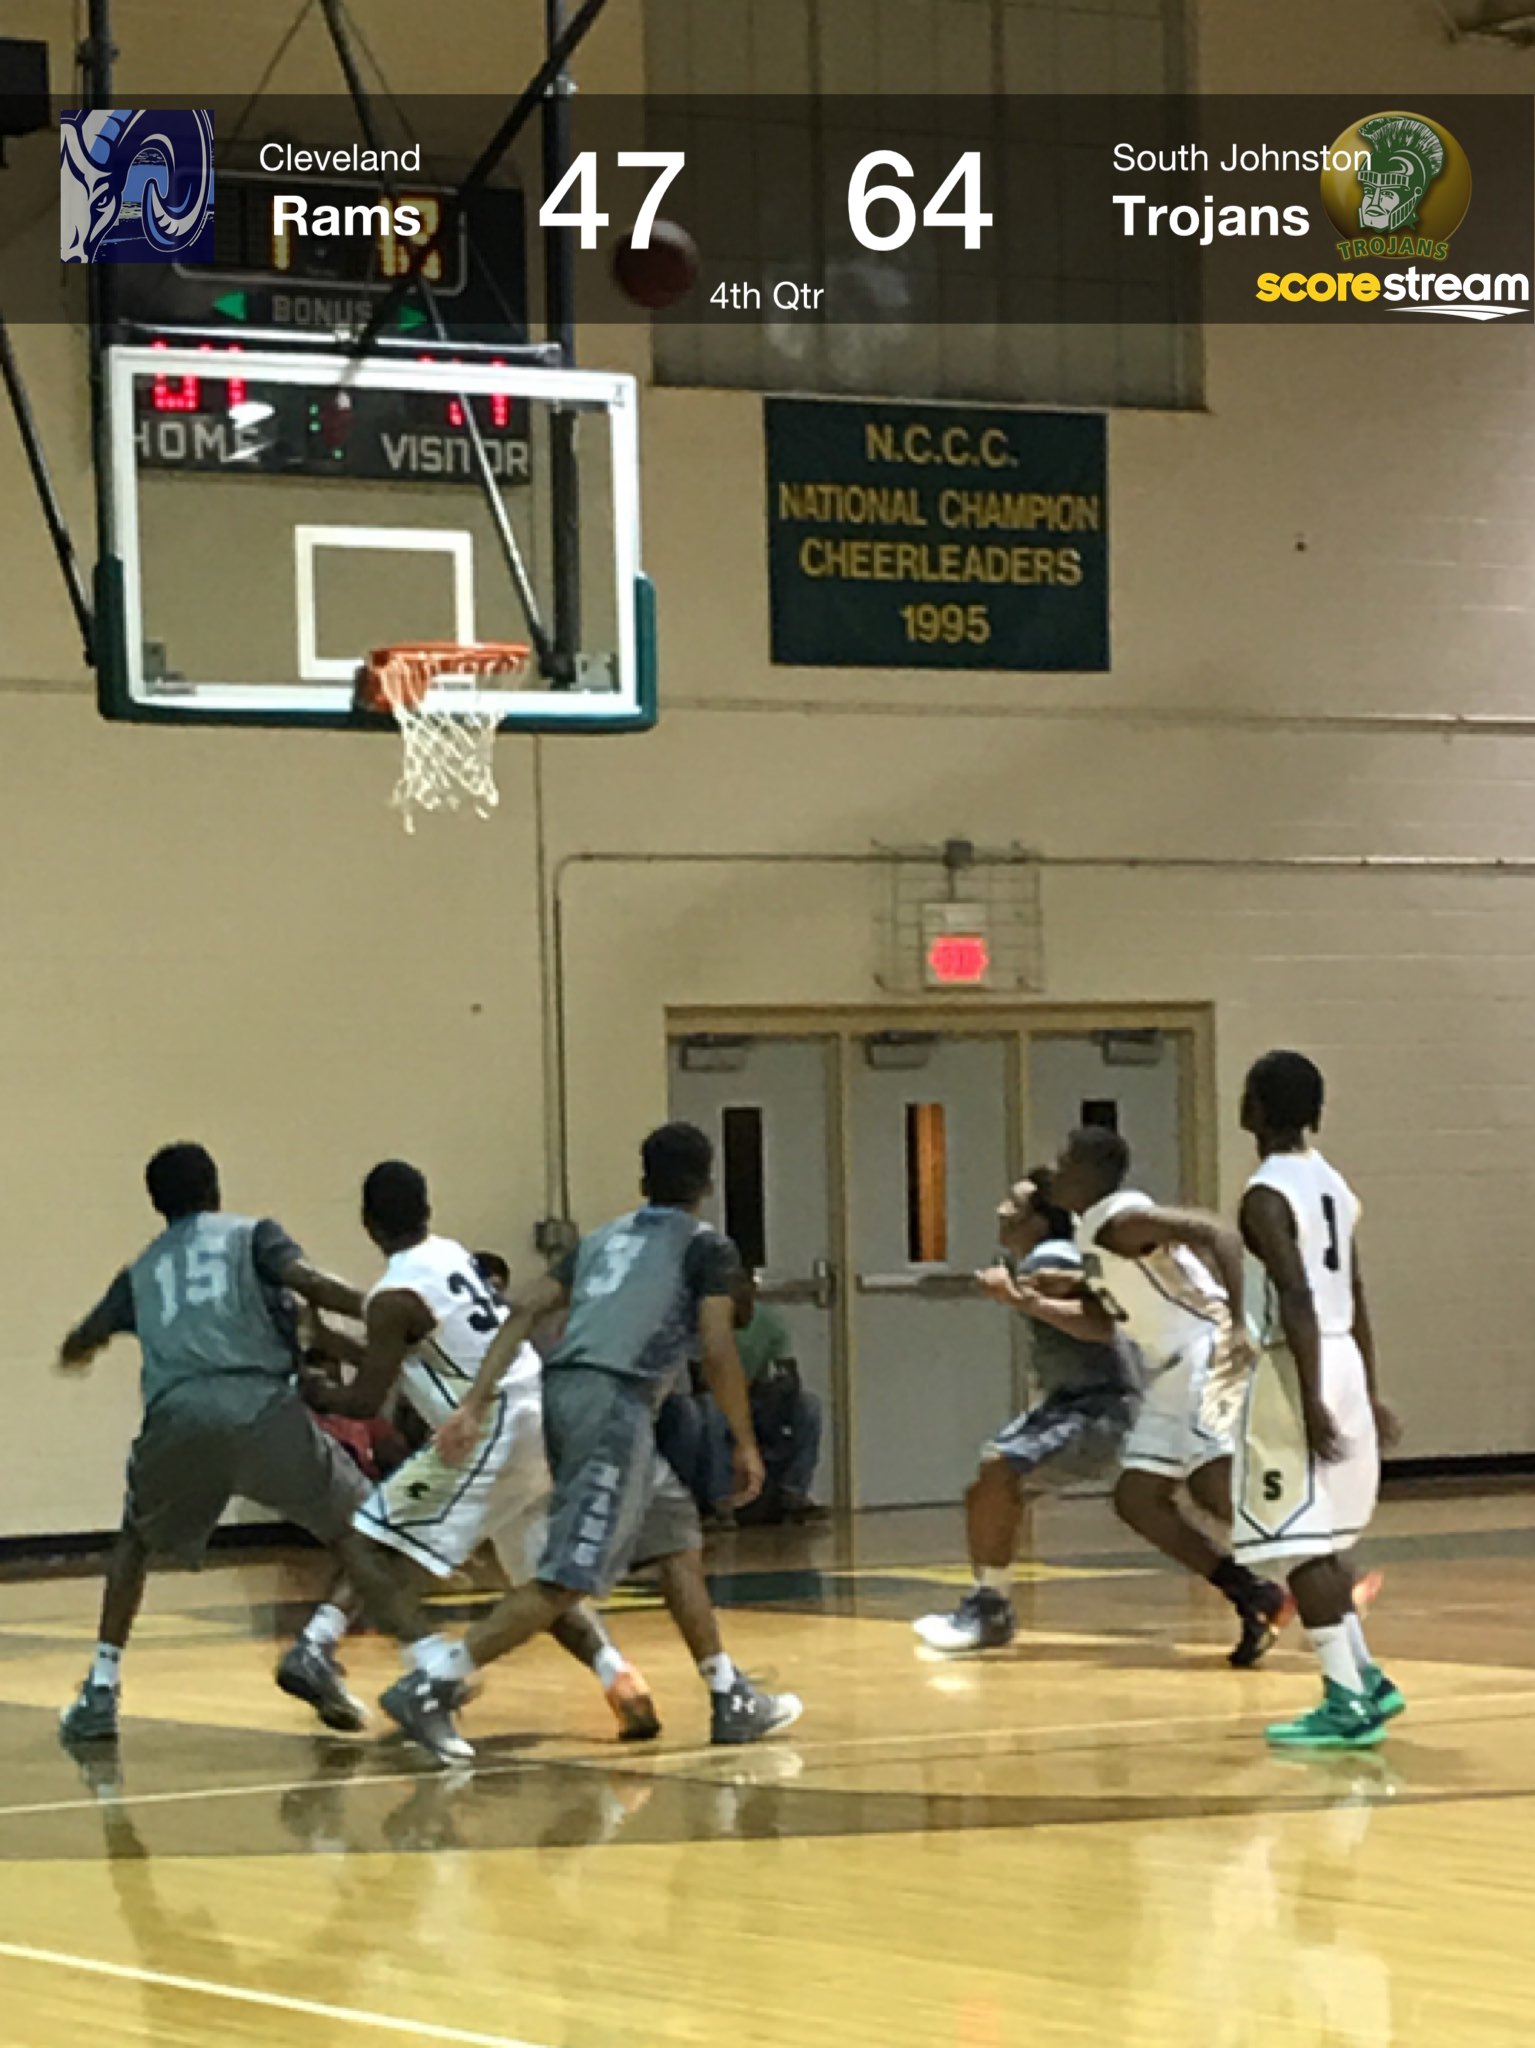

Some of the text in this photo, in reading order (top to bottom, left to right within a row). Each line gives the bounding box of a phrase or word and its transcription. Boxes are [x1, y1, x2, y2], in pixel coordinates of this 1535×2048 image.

[271, 295, 375, 330] BONUS
[864, 424, 1018, 467] N.C.C.C.
[779, 482, 1098, 532] NATIONAL CHAMPION
[800, 536, 1083, 586] CHEERLEADERS
[900, 603, 991, 644] 1995
[155, 1235, 228, 1328] 15
[1263, 1469, 1282, 1501] S
